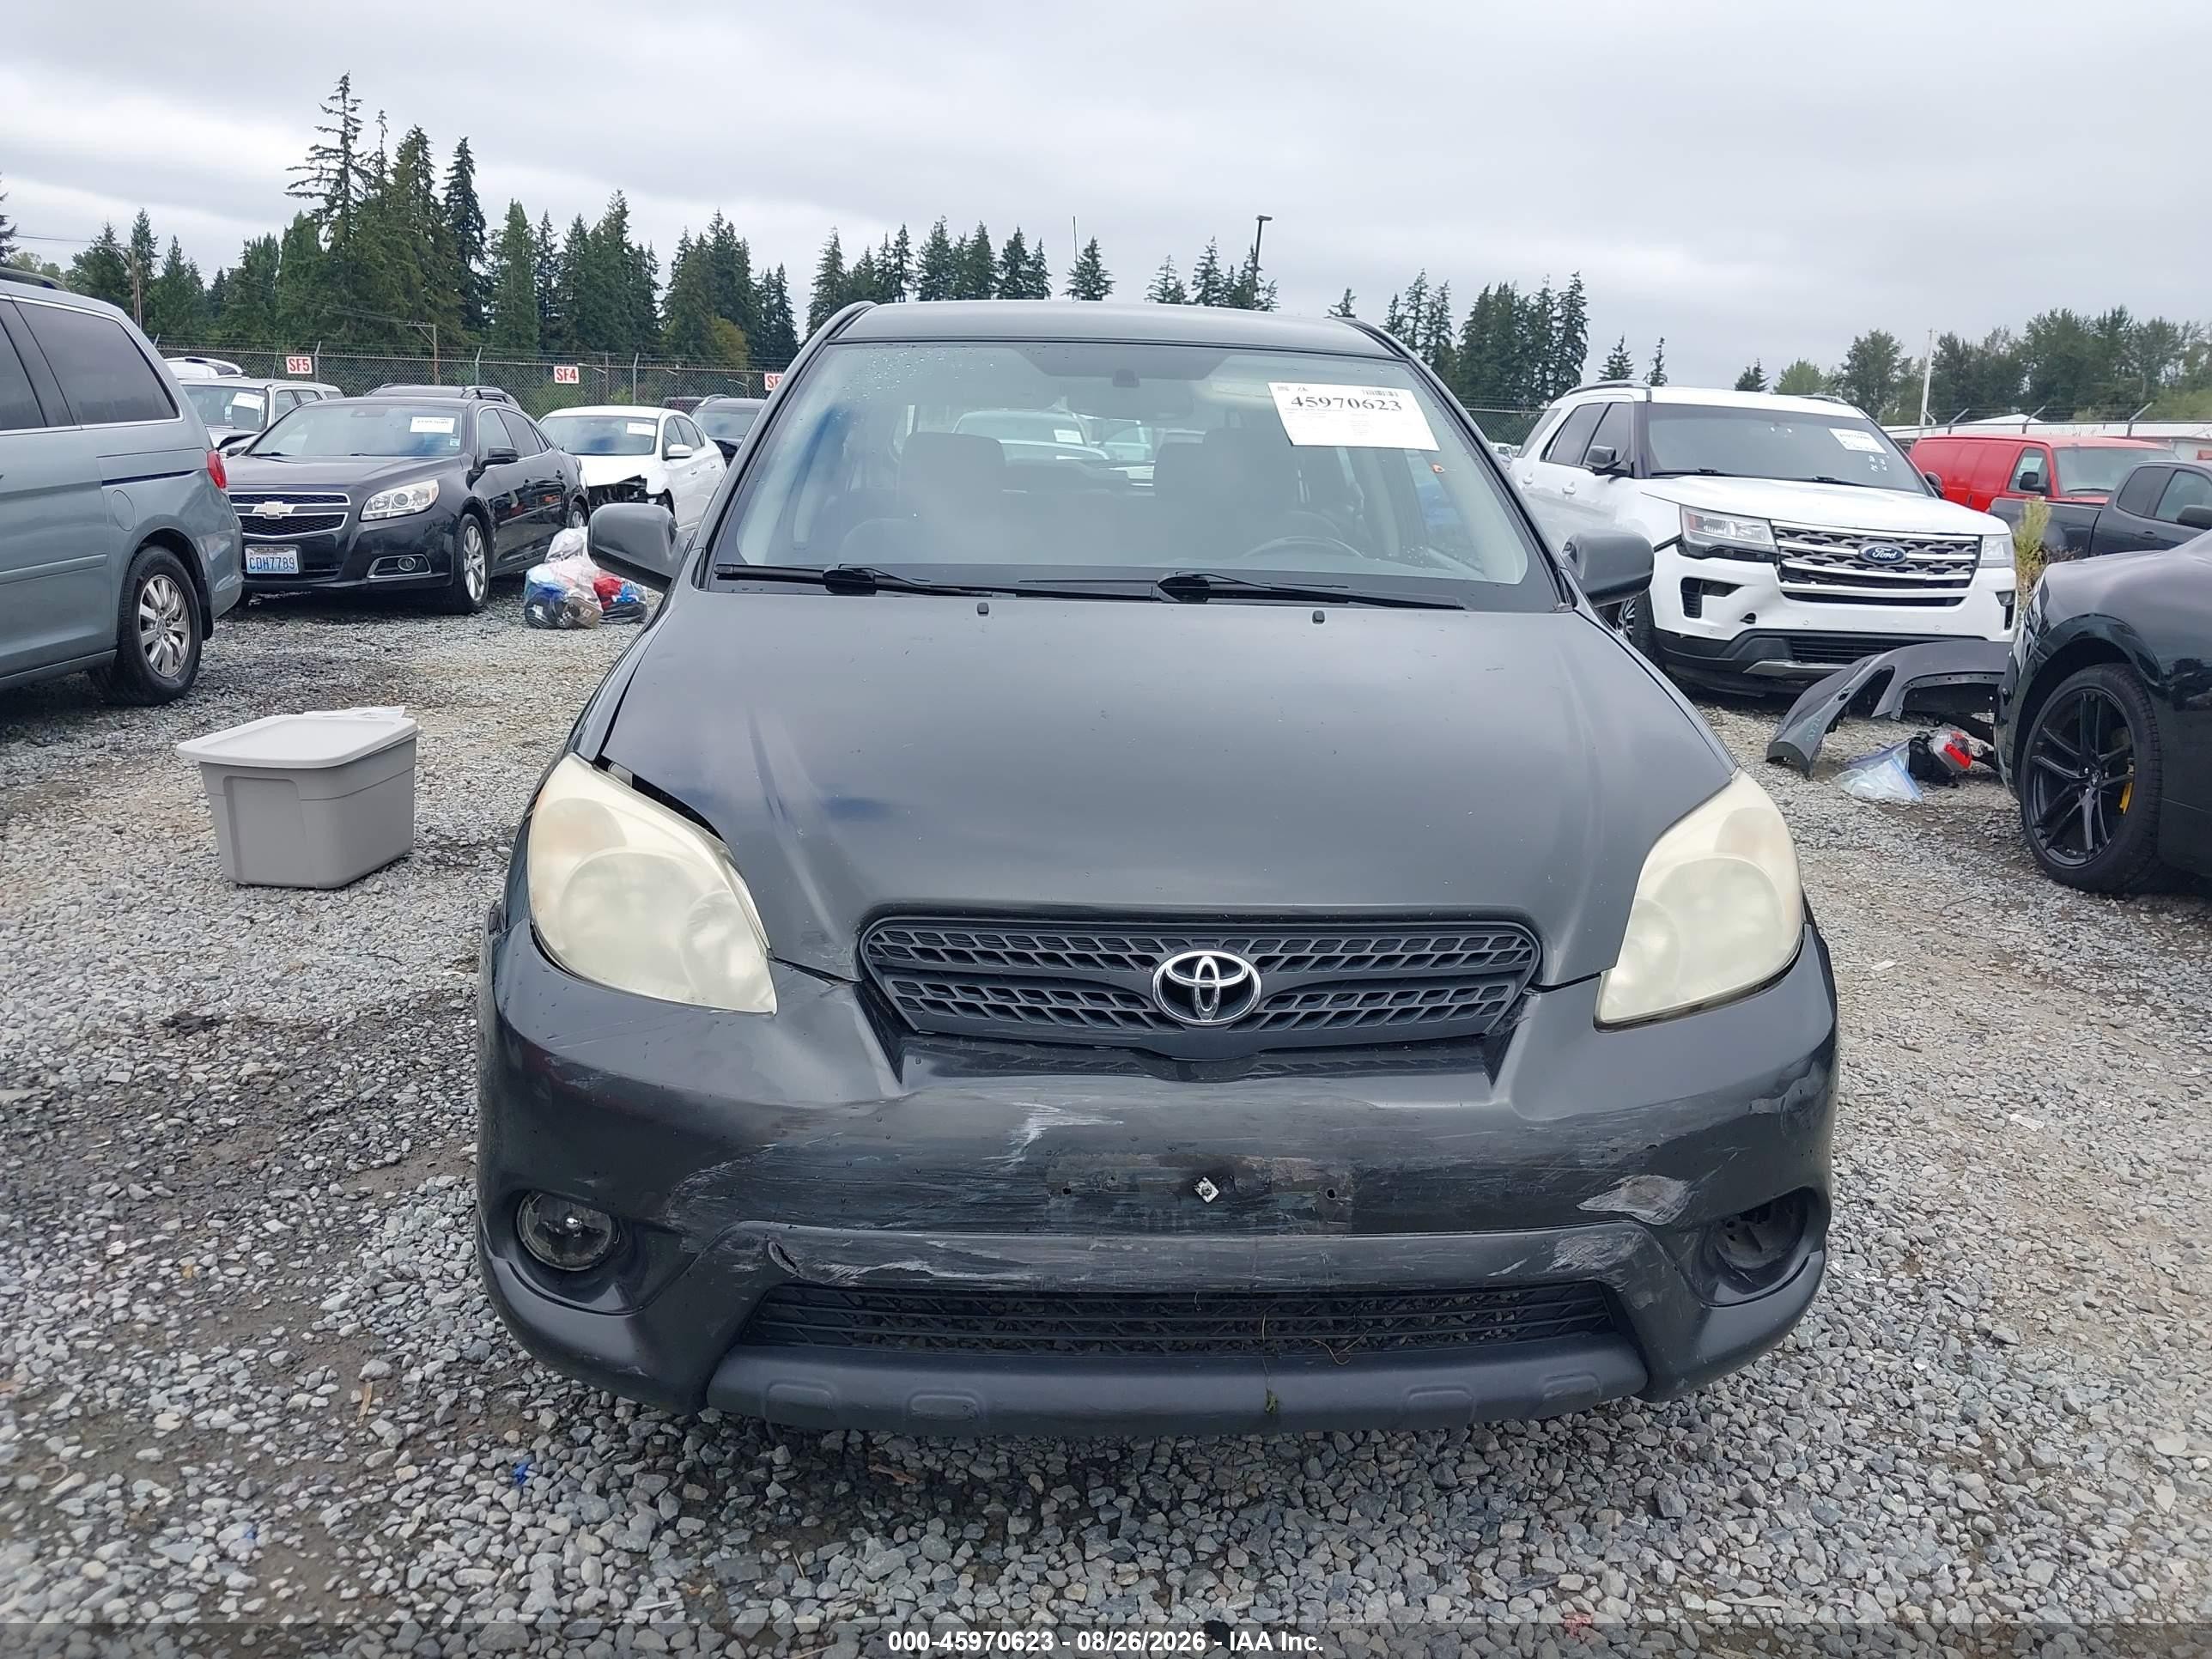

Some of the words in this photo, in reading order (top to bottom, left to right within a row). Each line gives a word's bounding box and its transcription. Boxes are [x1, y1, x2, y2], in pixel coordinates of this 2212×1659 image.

[288, 357, 310, 372] SF5
[556, 368, 577, 381] SF4
[767, 374, 783, 389] SF
[1291, 396, 1402, 411] 45970623
[1872, 546, 1898, 559] Ford
[249, 556, 295, 570] CDH7789
